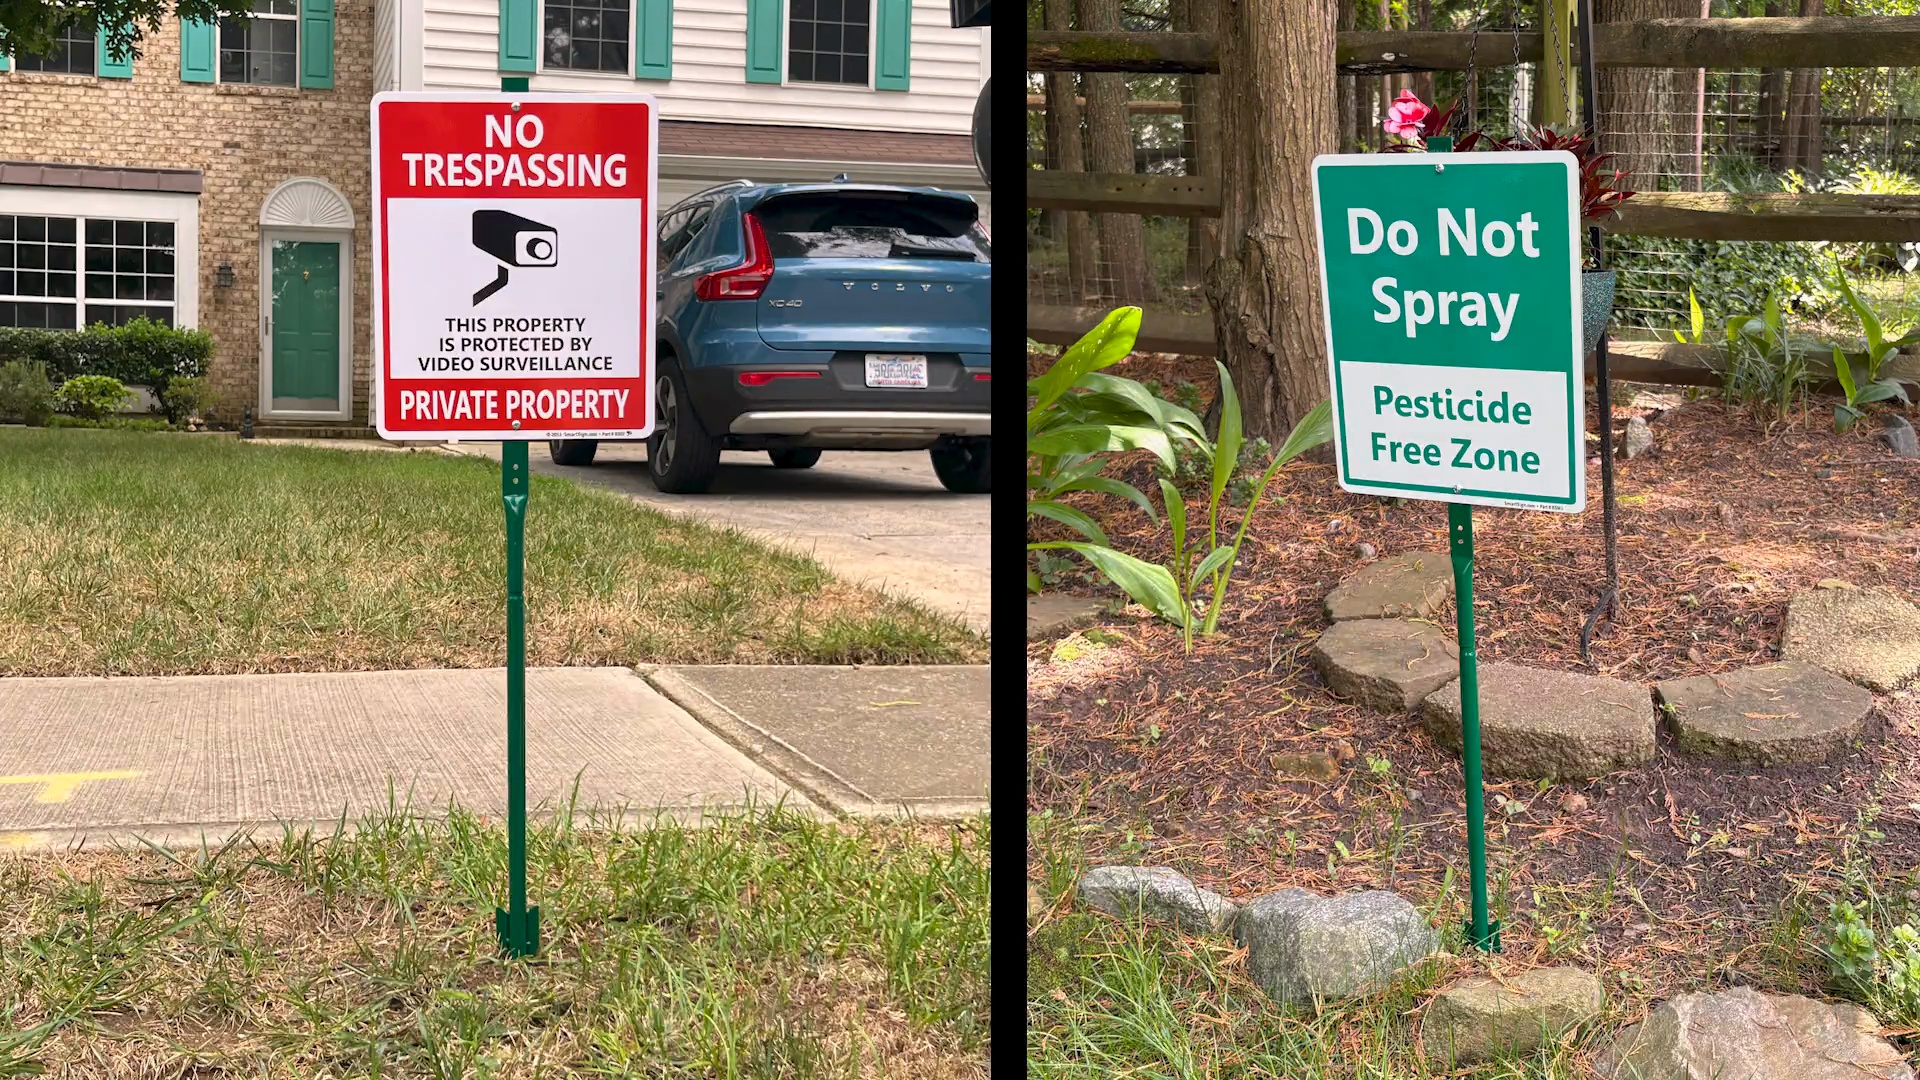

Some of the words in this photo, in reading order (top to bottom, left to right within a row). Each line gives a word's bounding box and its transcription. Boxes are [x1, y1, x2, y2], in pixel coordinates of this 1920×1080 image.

[484, 114, 544, 149] NO
[401, 152, 627, 188] TRESPASSING
[1347, 207, 1419, 256] Do
[1437, 207, 1541, 258] Not
[842, 281, 954, 293] VOLVO
[445, 317, 487, 333] THIS
[493, 317, 586, 333] PROPERTY
[1371, 276, 1521, 342] Spray
[439, 337, 455, 352] IS
[461, 337, 565, 352] PROTECTED
[570, 337, 593, 352] BY
[418, 357, 475, 372] VIDEO
[480, 356, 613, 372] SURVEILLANCE
[400, 389, 498, 421] PRIVATE
[505, 388, 630, 420] PROPERTY
[1373, 385, 1532, 425] Pesticide
[1371, 431, 1442, 467] Free
[1450, 437, 1541, 475] Zone
